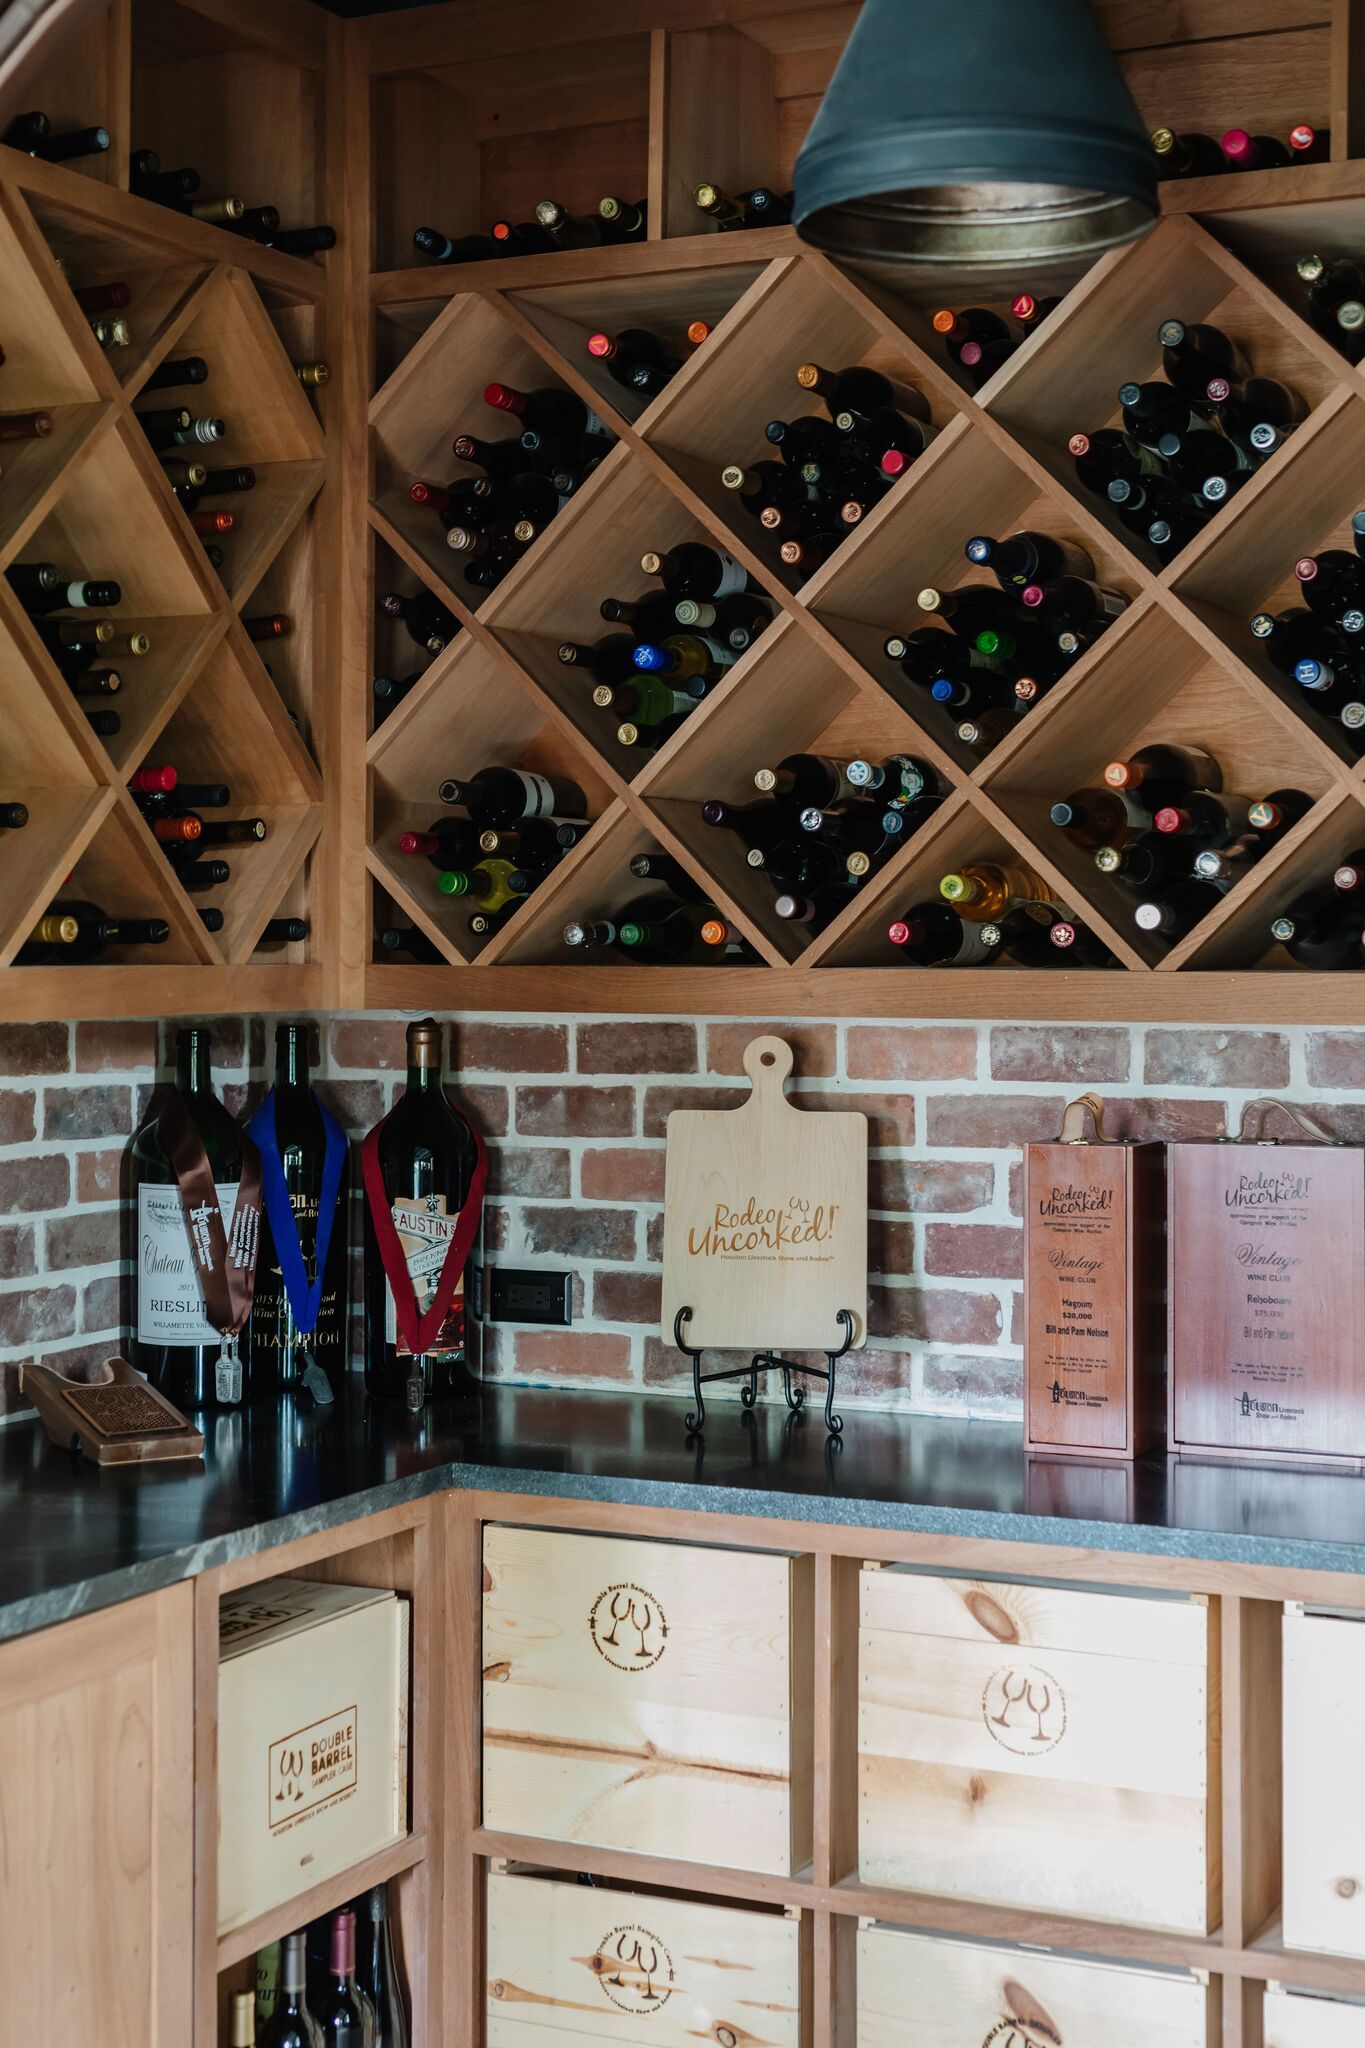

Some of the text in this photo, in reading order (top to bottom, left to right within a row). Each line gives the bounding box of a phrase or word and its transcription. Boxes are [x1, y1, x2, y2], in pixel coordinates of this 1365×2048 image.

[1052, 1184, 1082, 1202] Rodeo
[1240, 1171, 1274, 1193] Rodeo
[400, 1213, 447, 1237] AUSTIN
[715, 1196, 776, 1231] Rodeo
[229, 1211, 241, 1258] International
[144, 1234, 184, 1275] Chateau
[1048, 1249, 1105, 1275] Vintage
[1235, 1243, 1303, 1273] Vintage
[1077, 1276, 1097, 1284] CLUB
[1246, 1273, 1267, 1281] WINE
[254, 1295, 272, 1304] 015
[153, 1321, 194, 1329] WILLAMETTE
[1046, 1324, 1109, 1338] Bill and Pam Nelson
[254, 1331, 339, 1348] HAMPION
[608, 1582, 629, 1592] Barrel
[630, 1583, 658, 1604] Sampler
[312, 1725, 352, 1758] DOUBLE
[312, 1745, 352, 1775] BARREL
[614, 1924, 635, 1934] Barrel
[637, 1925, 664, 1948] Sampler
